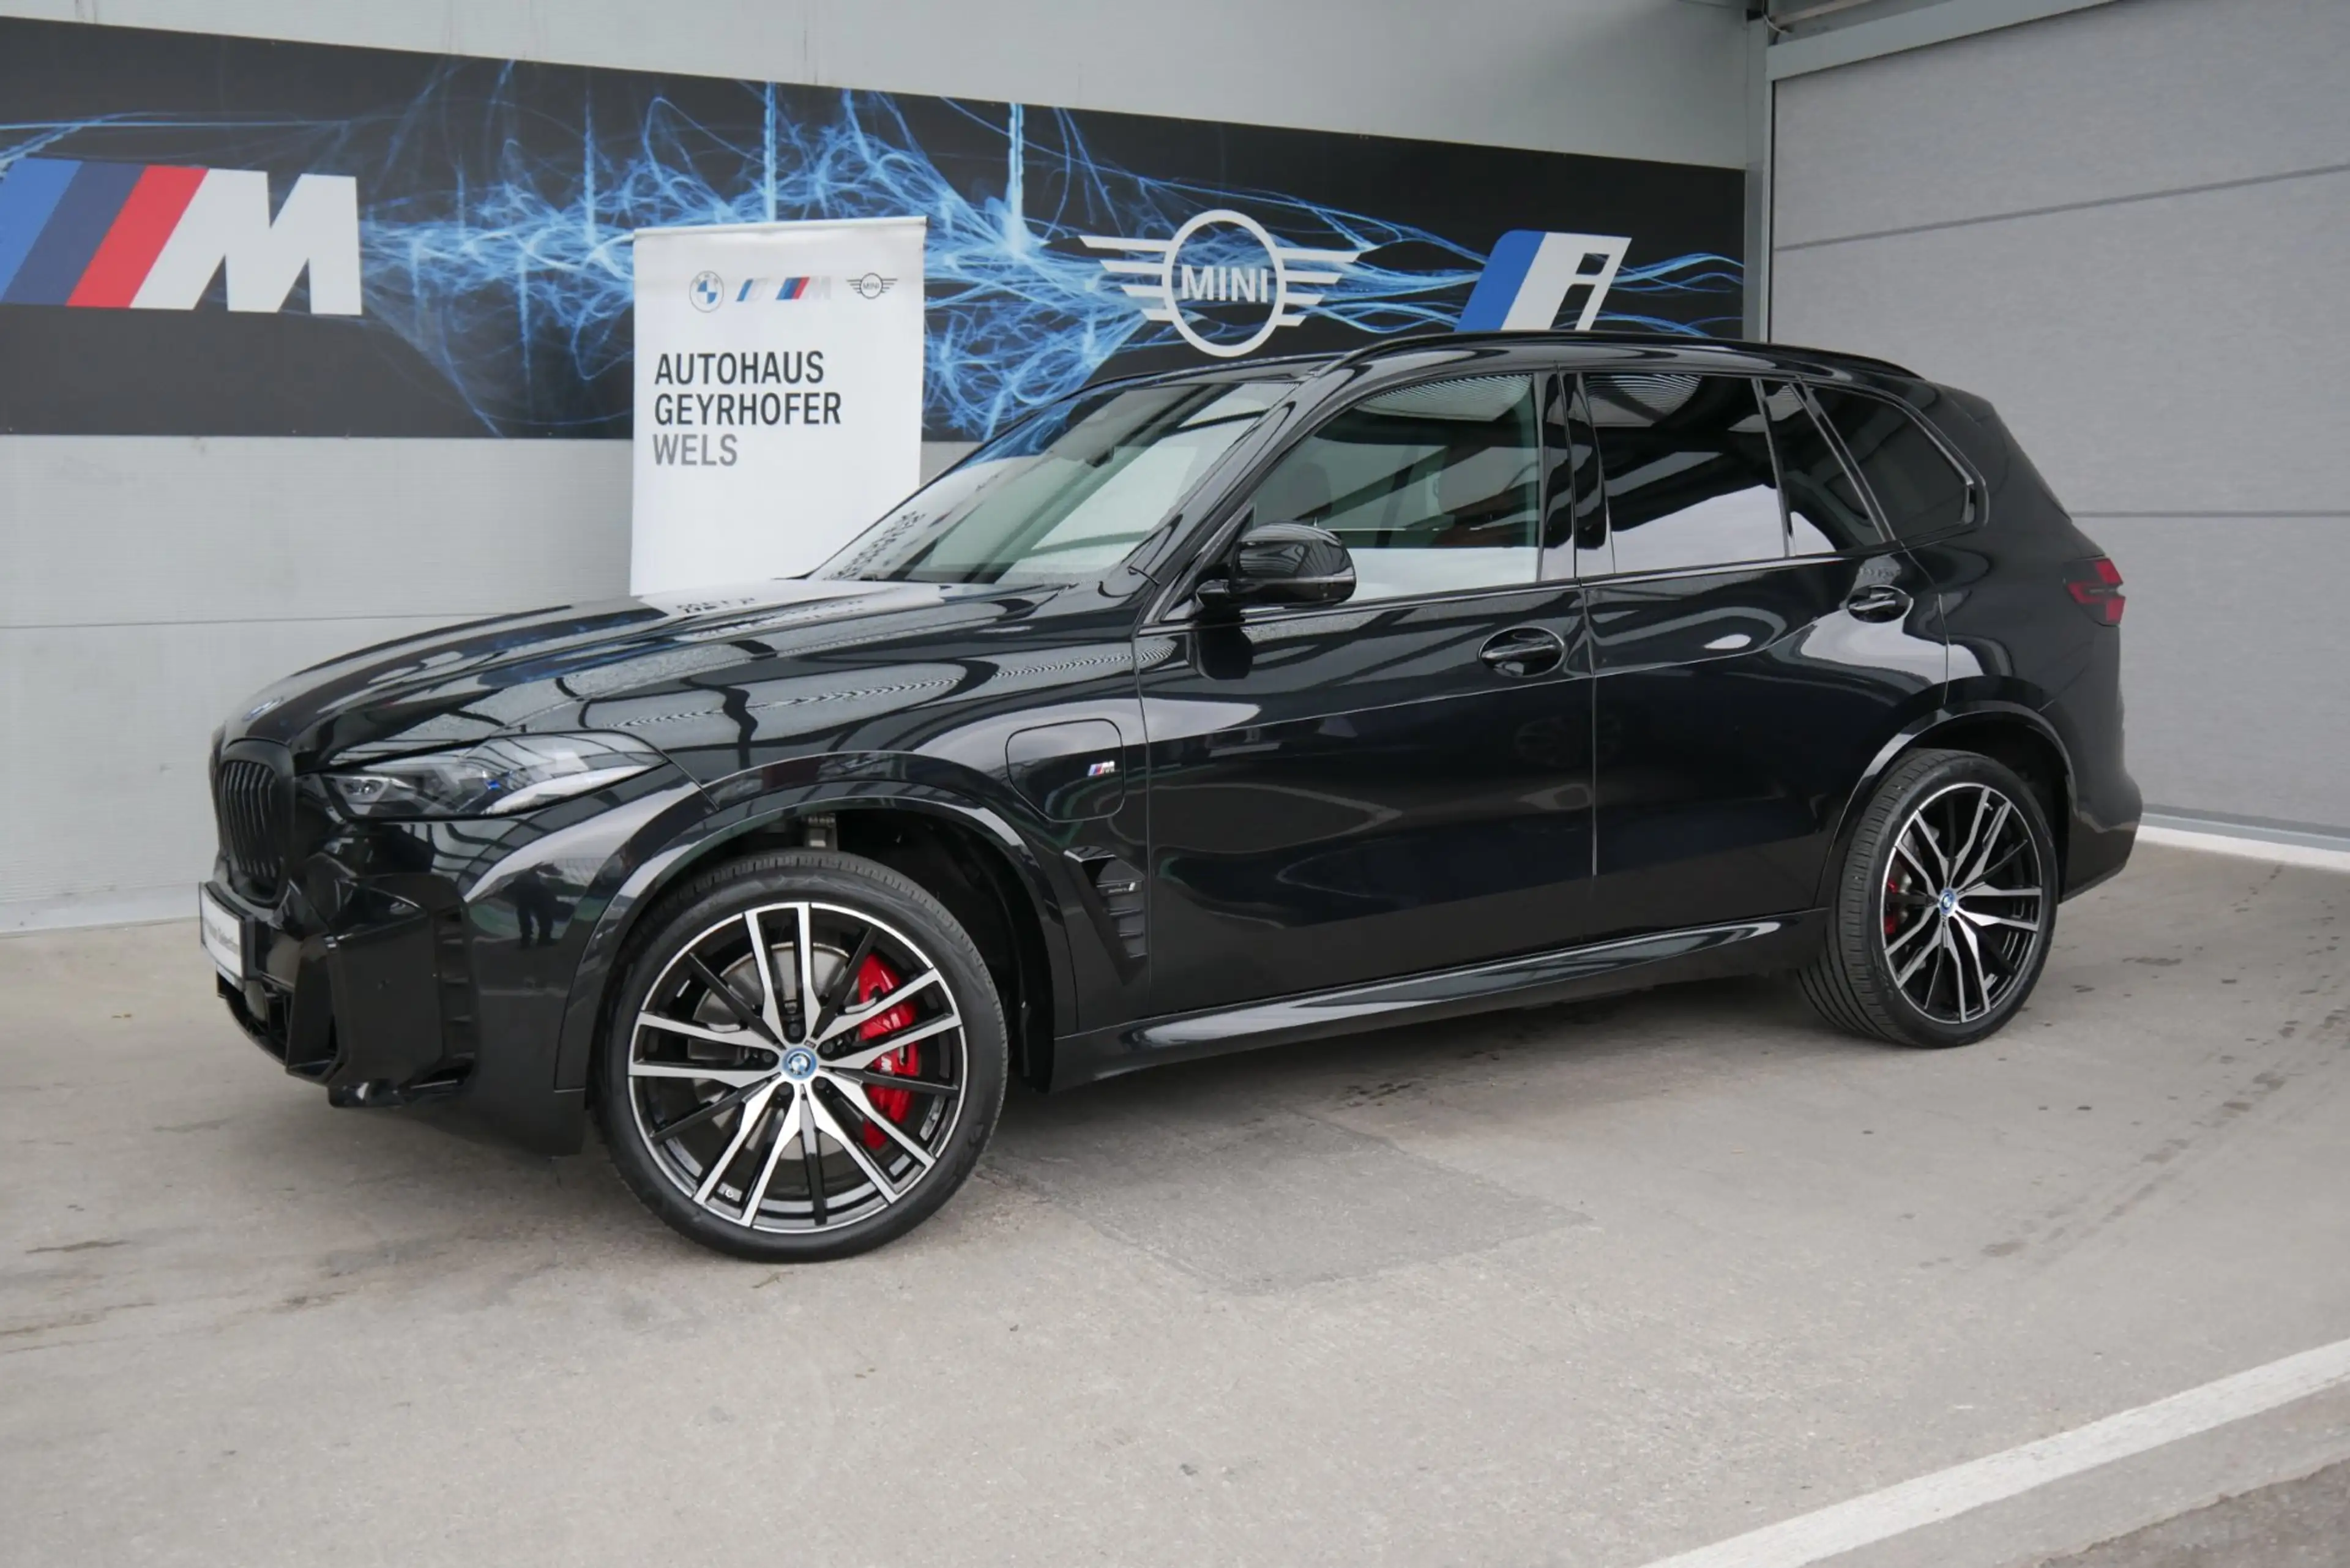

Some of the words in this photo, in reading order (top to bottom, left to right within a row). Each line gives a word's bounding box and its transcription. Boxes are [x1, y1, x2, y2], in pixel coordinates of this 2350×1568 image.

[129, 168, 362, 315] M
[1181, 264, 1268, 303] MINI
[654, 350, 824, 385] AUTOHAUS
[654, 392, 841, 425] GEYRHOFER
[652, 433, 738, 466] WELS
